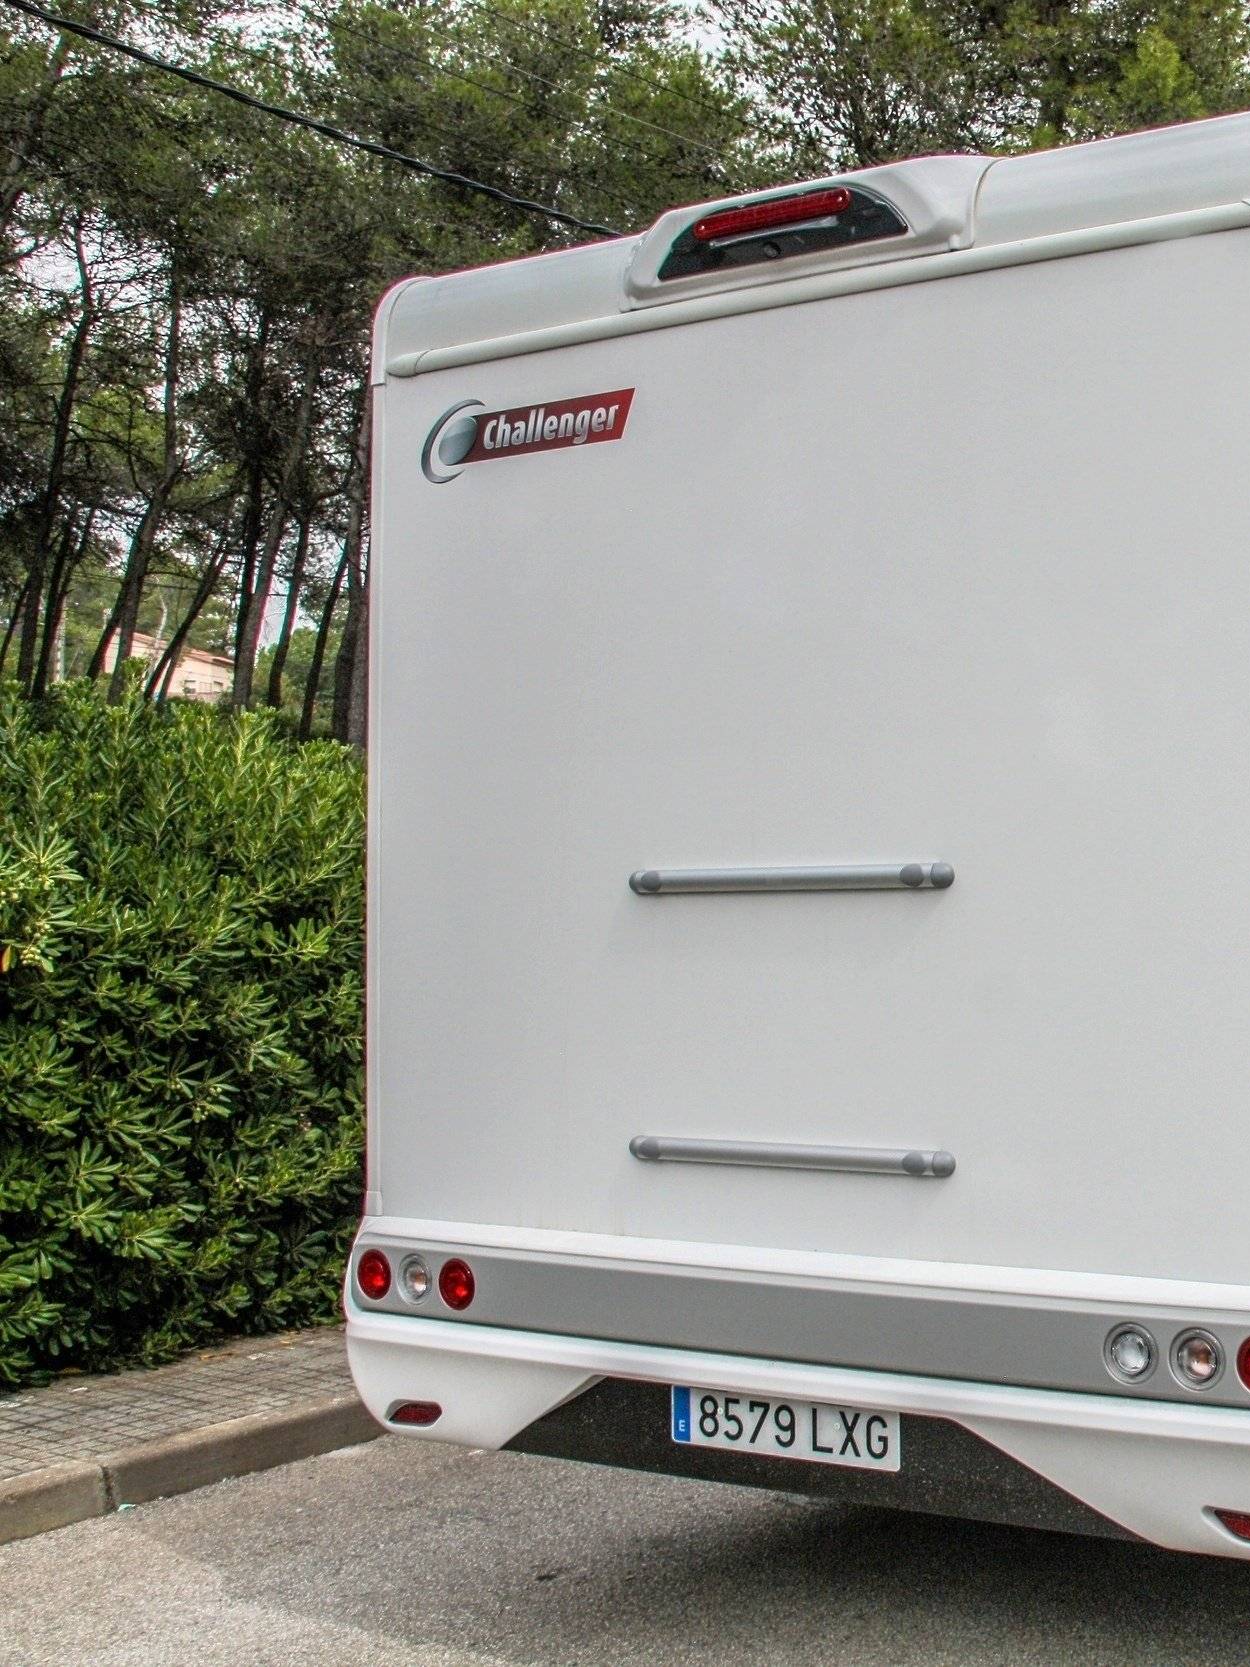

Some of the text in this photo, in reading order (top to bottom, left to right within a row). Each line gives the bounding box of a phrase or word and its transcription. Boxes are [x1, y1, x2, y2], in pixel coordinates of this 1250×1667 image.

[483, 404, 620, 449] Challenger
[678, 1419, 685, 1432] E
[699, 1394, 889, 1460] 8579 LXG
